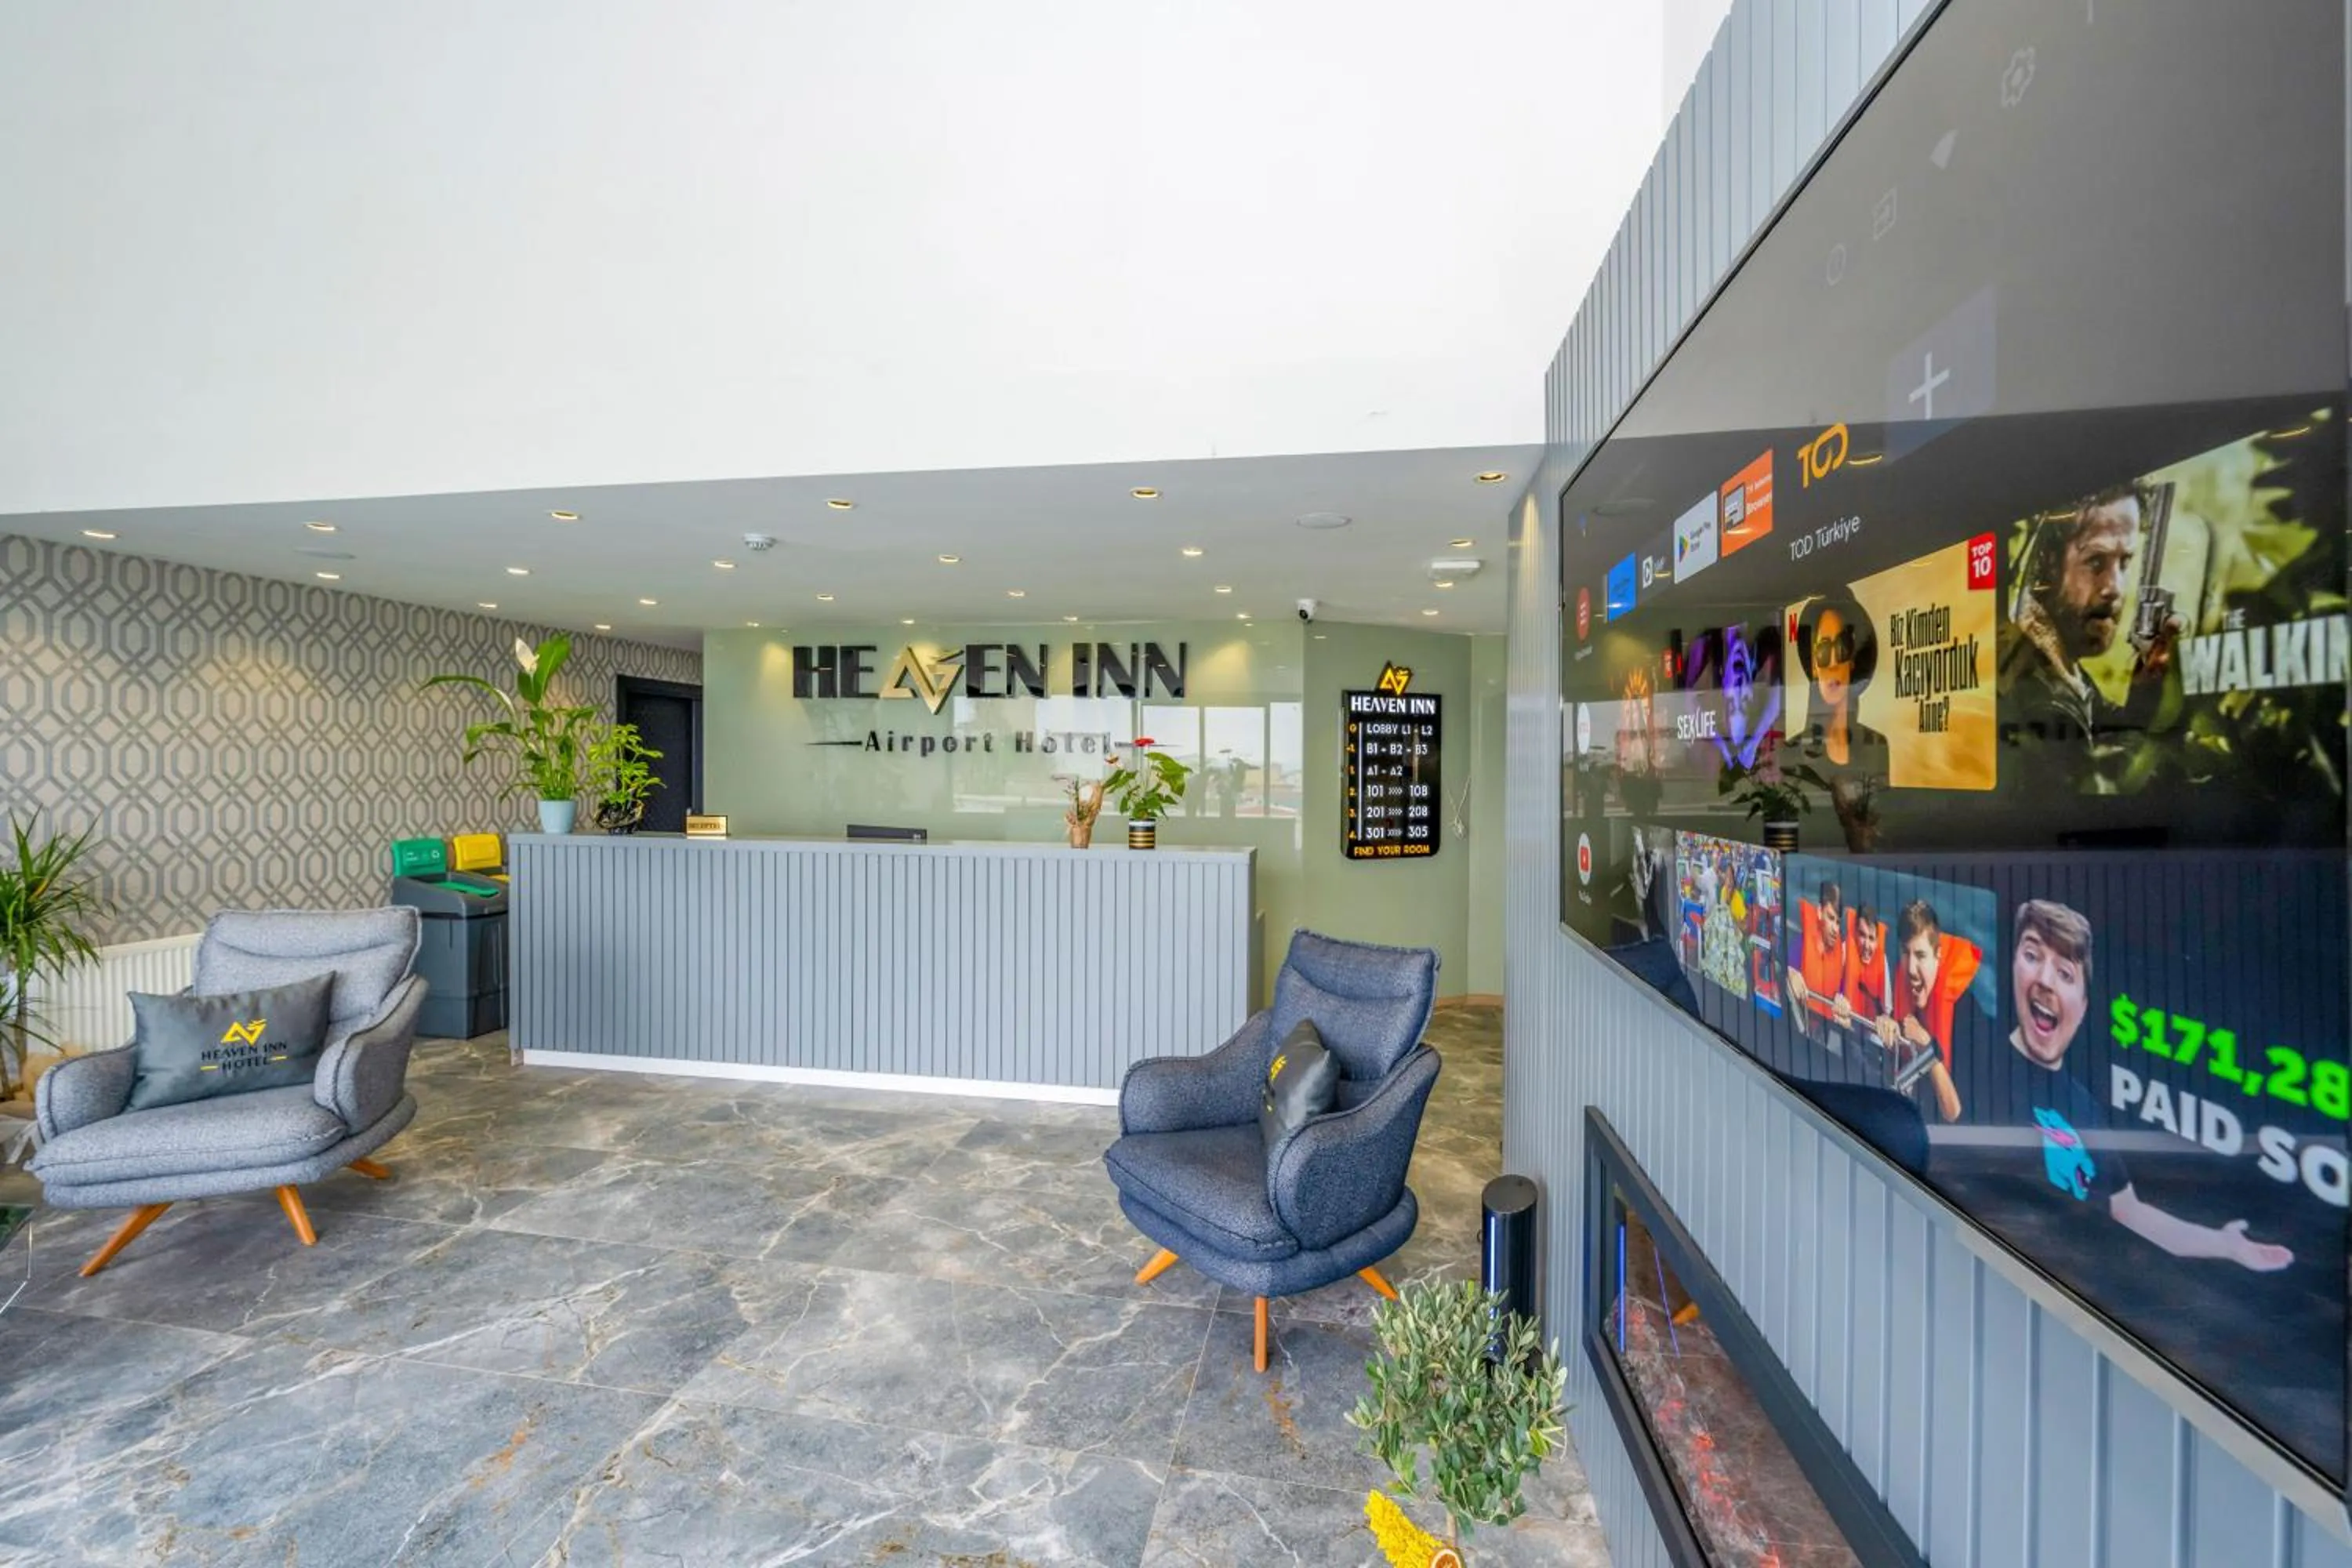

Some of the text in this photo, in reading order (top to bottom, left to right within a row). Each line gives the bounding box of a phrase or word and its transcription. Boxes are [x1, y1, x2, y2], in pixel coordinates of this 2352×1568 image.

[1790, 515, 1861, 561] TOD Türkiye
[1972, 542, 1993, 557] TOP
[1973, 556, 1992, 578] 10
[1890, 602, 1951, 650] Biz Kimden
[1895, 633, 1980, 702] Kaçıyorduk
[792, 641, 1188, 715] HEAVEN INN
[1351, 695, 1436, 714] HEAVEN INN
[1918, 695, 1951, 733] Anne?
[1367, 723, 1398, 735] LOBBY
[1402, 724, 1410, 735] L1
[1421, 725, 1433, 736] L2
[865, 730, 1111, 757] Airport Hotel
[1367, 742, 1377, 755] B1
[1390, 743, 1403, 755] B2
[1415, 744, 1428, 755] B3
[1367, 765, 1377, 776] A1
[1390, 765, 1403, 776] A2
[1367, 785, 1384, 797] 101
[1410, 786, 1428, 797] 108
[1367, 807, 1384, 818] 201
[1409, 807, 1428, 818] 208
[1367, 827, 1384, 839] 301
[1408, 827, 1428, 838] 305
[1354, 844, 1430, 857] FIND YOUR ROOM
[201, 1040, 287, 1061] HEAVEN INN
[2110, 993, 2350, 1121] $171,28
[222, 1056, 270, 1070] HOTEL
[2110, 1064, 2245, 1157] PAID
